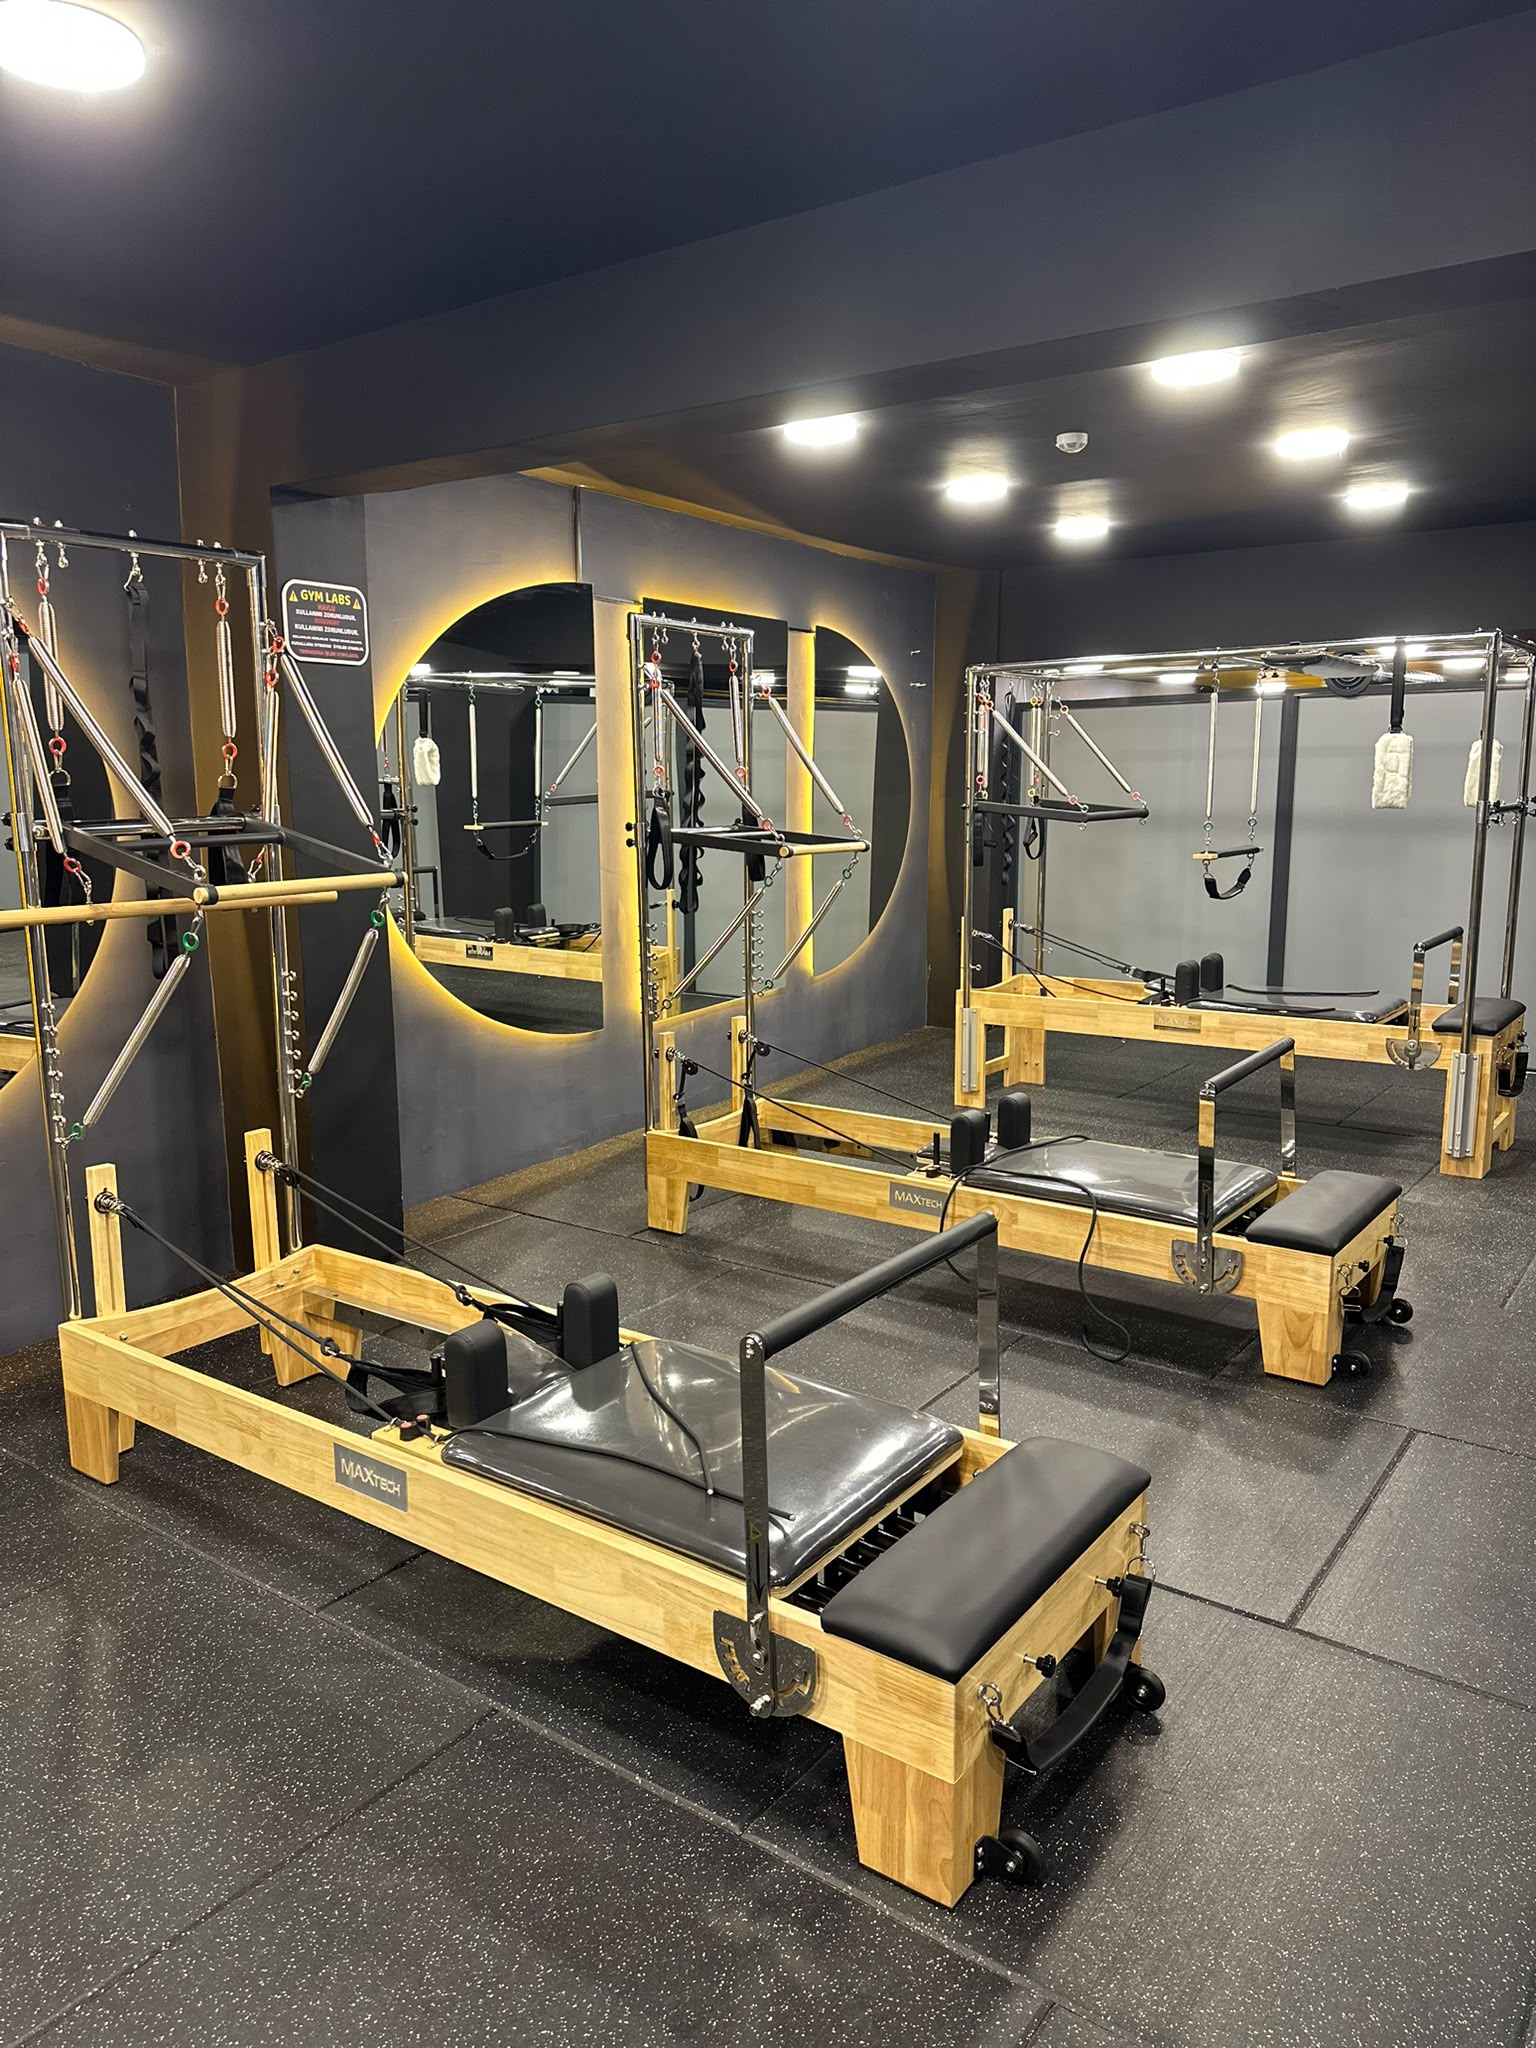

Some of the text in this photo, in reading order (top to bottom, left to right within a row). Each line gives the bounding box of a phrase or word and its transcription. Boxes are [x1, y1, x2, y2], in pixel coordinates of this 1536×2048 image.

[300, 589, 351, 606] GYM LABS
[894, 1190, 943, 1209] MAXTECH
[341, 1458, 400, 1497] MAXTECH
